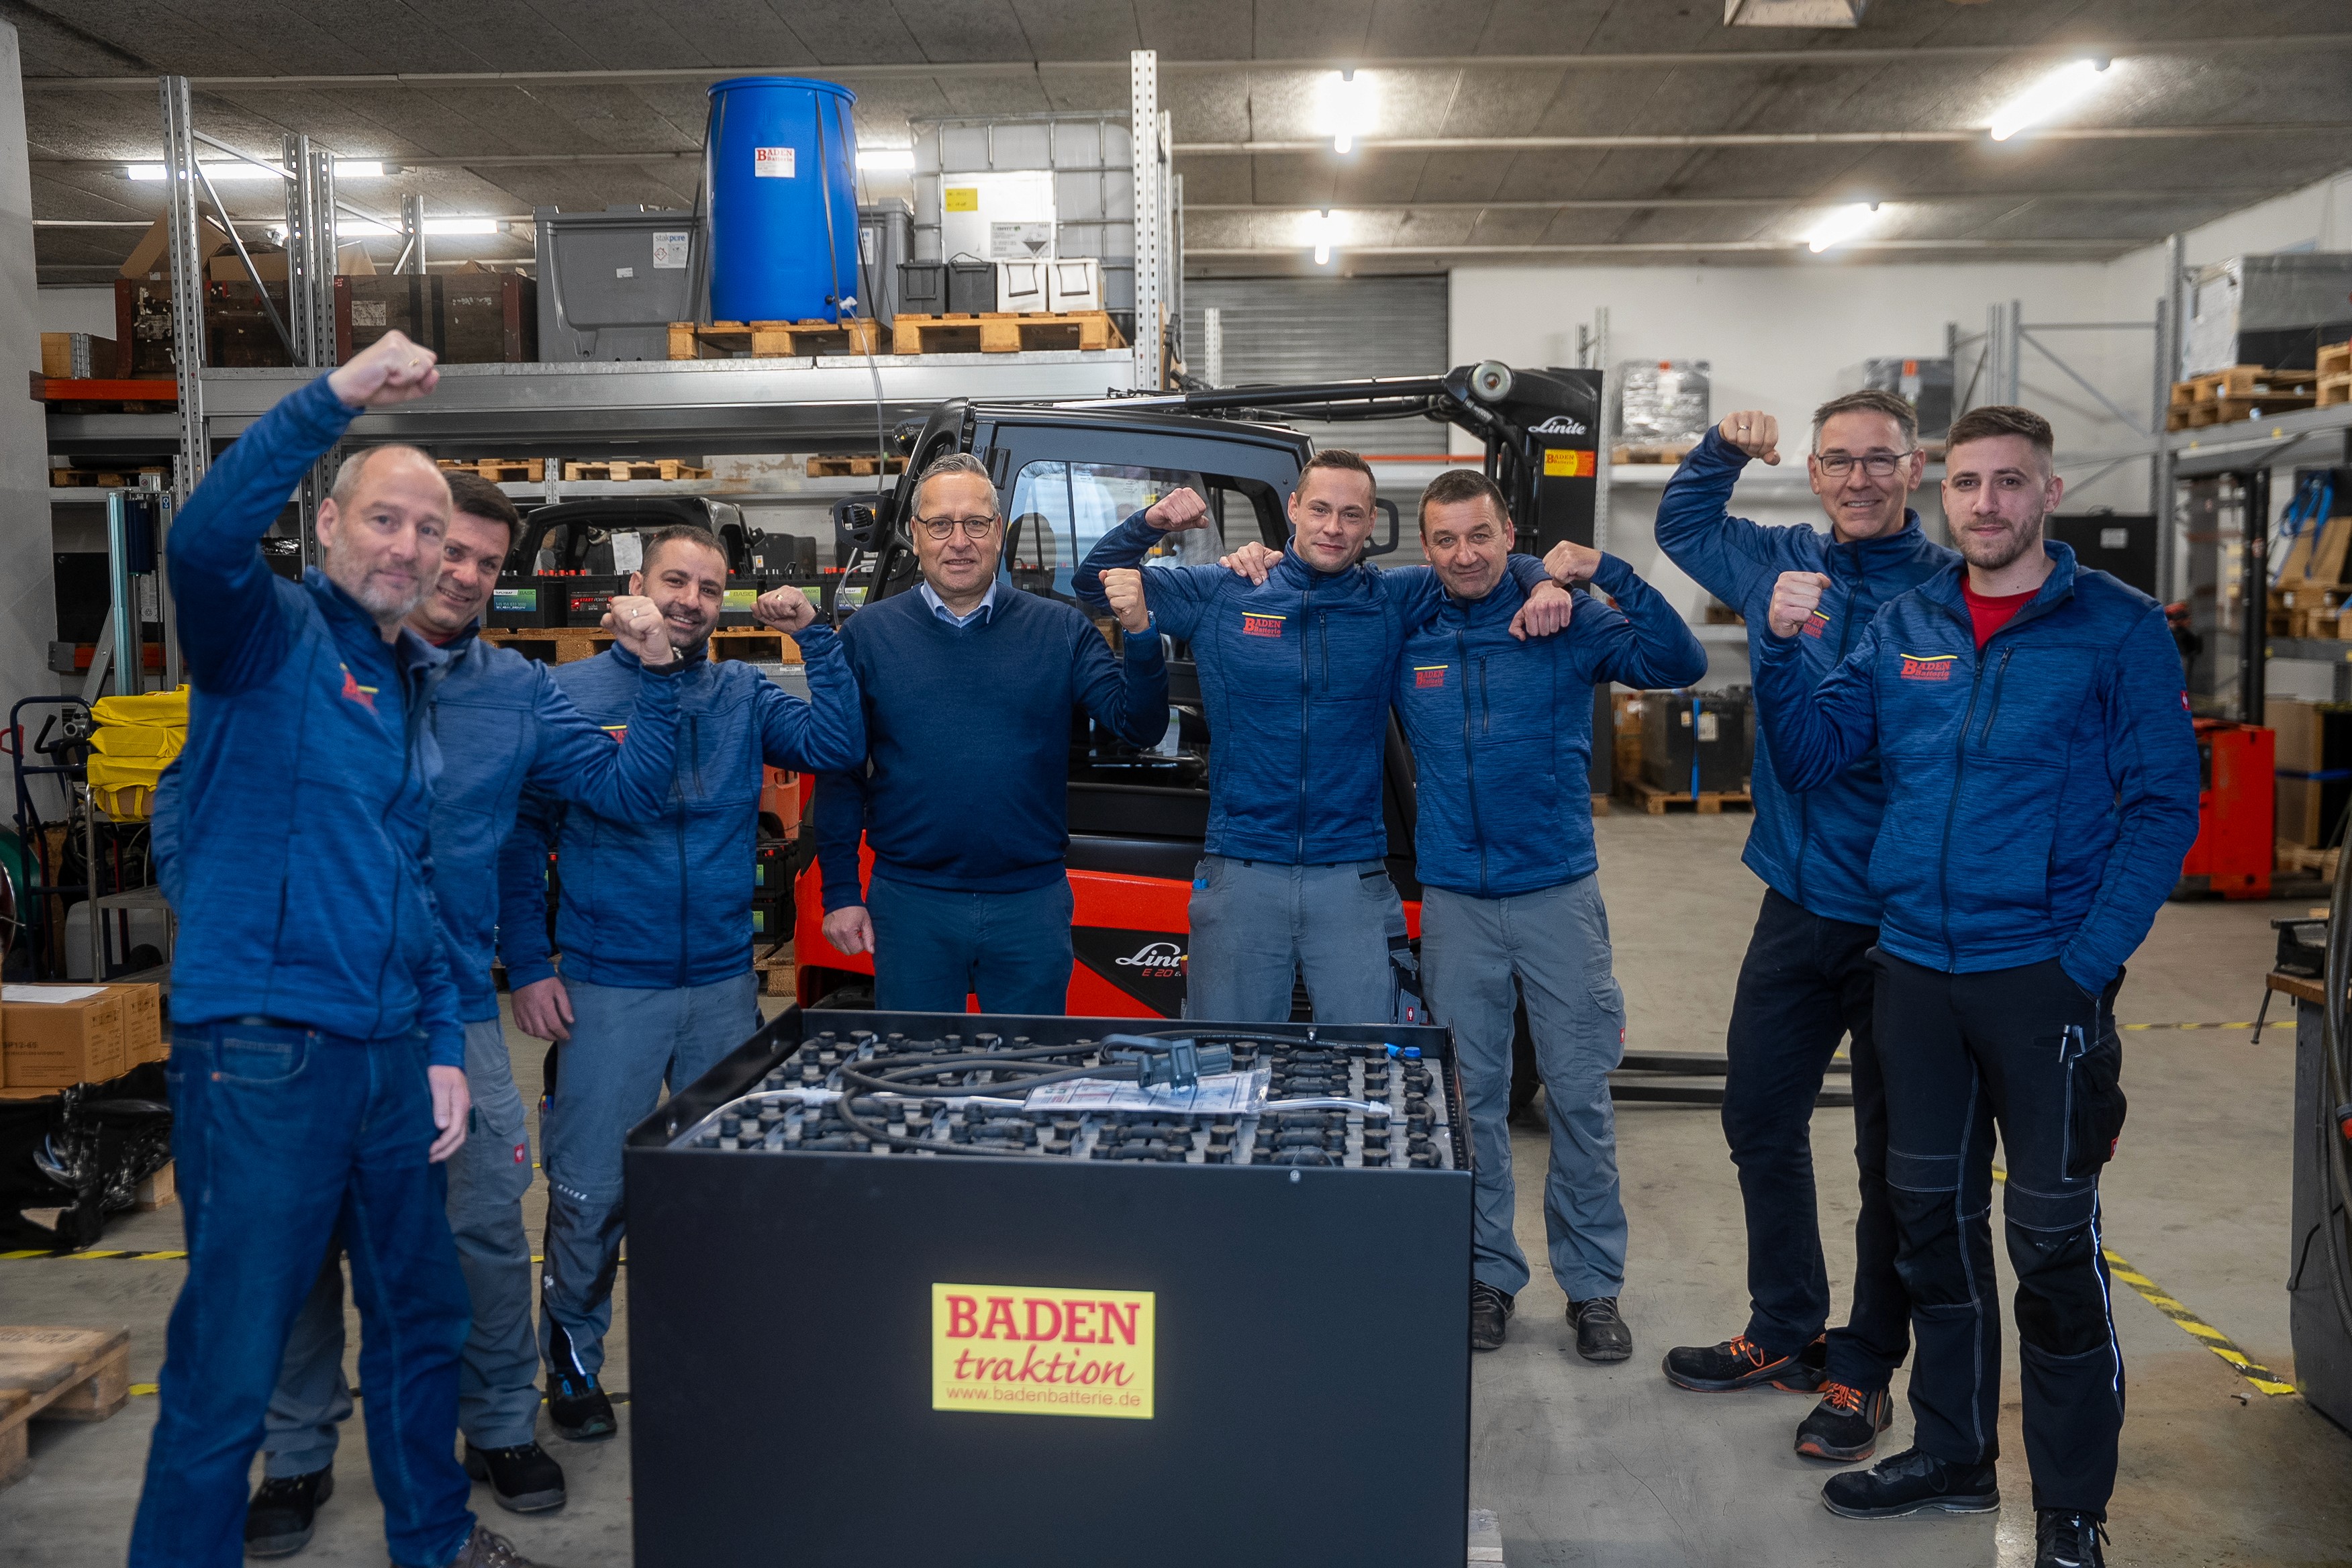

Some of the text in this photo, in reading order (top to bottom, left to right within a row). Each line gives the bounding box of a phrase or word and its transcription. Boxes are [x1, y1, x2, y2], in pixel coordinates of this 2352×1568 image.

[756, 149, 792, 161] BADEN
[655, 234, 685, 242] stakpure
[1528, 415, 1587, 435] Linde
[1546, 454, 1574, 464] BADEN
[1243, 618, 1281, 631] BADEN
[1901, 660, 1951, 675] BADEN
[1416, 670, 1444, 685] BADEN
[1142, 969, 1153, 977] E
[1155, 969, 1173, 977] 20
[946, 1294, 1140, 1345] BADEN
[954, 1343, 1134, 1386] traktion
[946, 1386, 1141, 1407] www.badenbatterie.de
